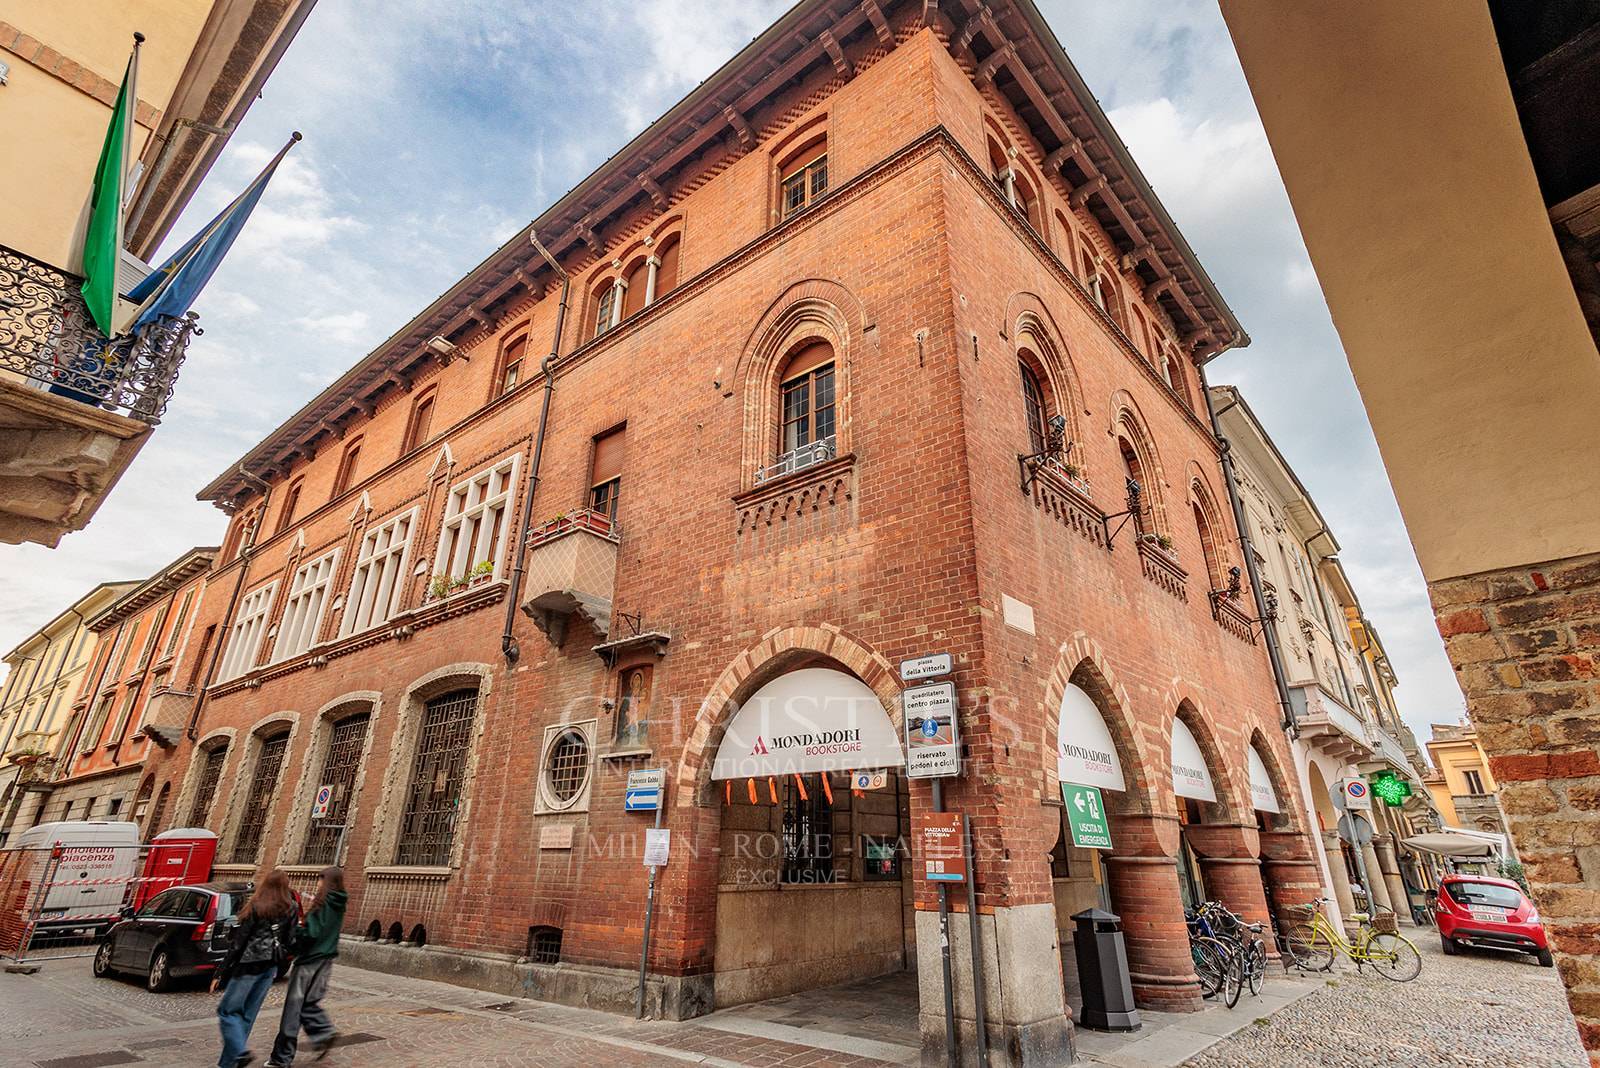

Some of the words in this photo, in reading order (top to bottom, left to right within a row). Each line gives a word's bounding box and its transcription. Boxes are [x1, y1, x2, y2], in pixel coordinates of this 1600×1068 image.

[923, 664, 946, 673] Vittoria
[907, 700, 928, 709] centro
[930, 698, 950, 707] piazza
[771, 728, 861, 750] MONDADORI
[805, 742, 861, 756] BOOKSTORE
[1063, 743, 1112, 765] MONDADORI
[917, 751, 947, 759] riservato
[911, 761, 933, 770] pedoni
[940, 758, 955, 767] cicli
[1079, 822, 1097, 833] USCITA
[1079, 834, 1109, 846] EMERGENZA
[60, 853, 115, 863] piacenza
